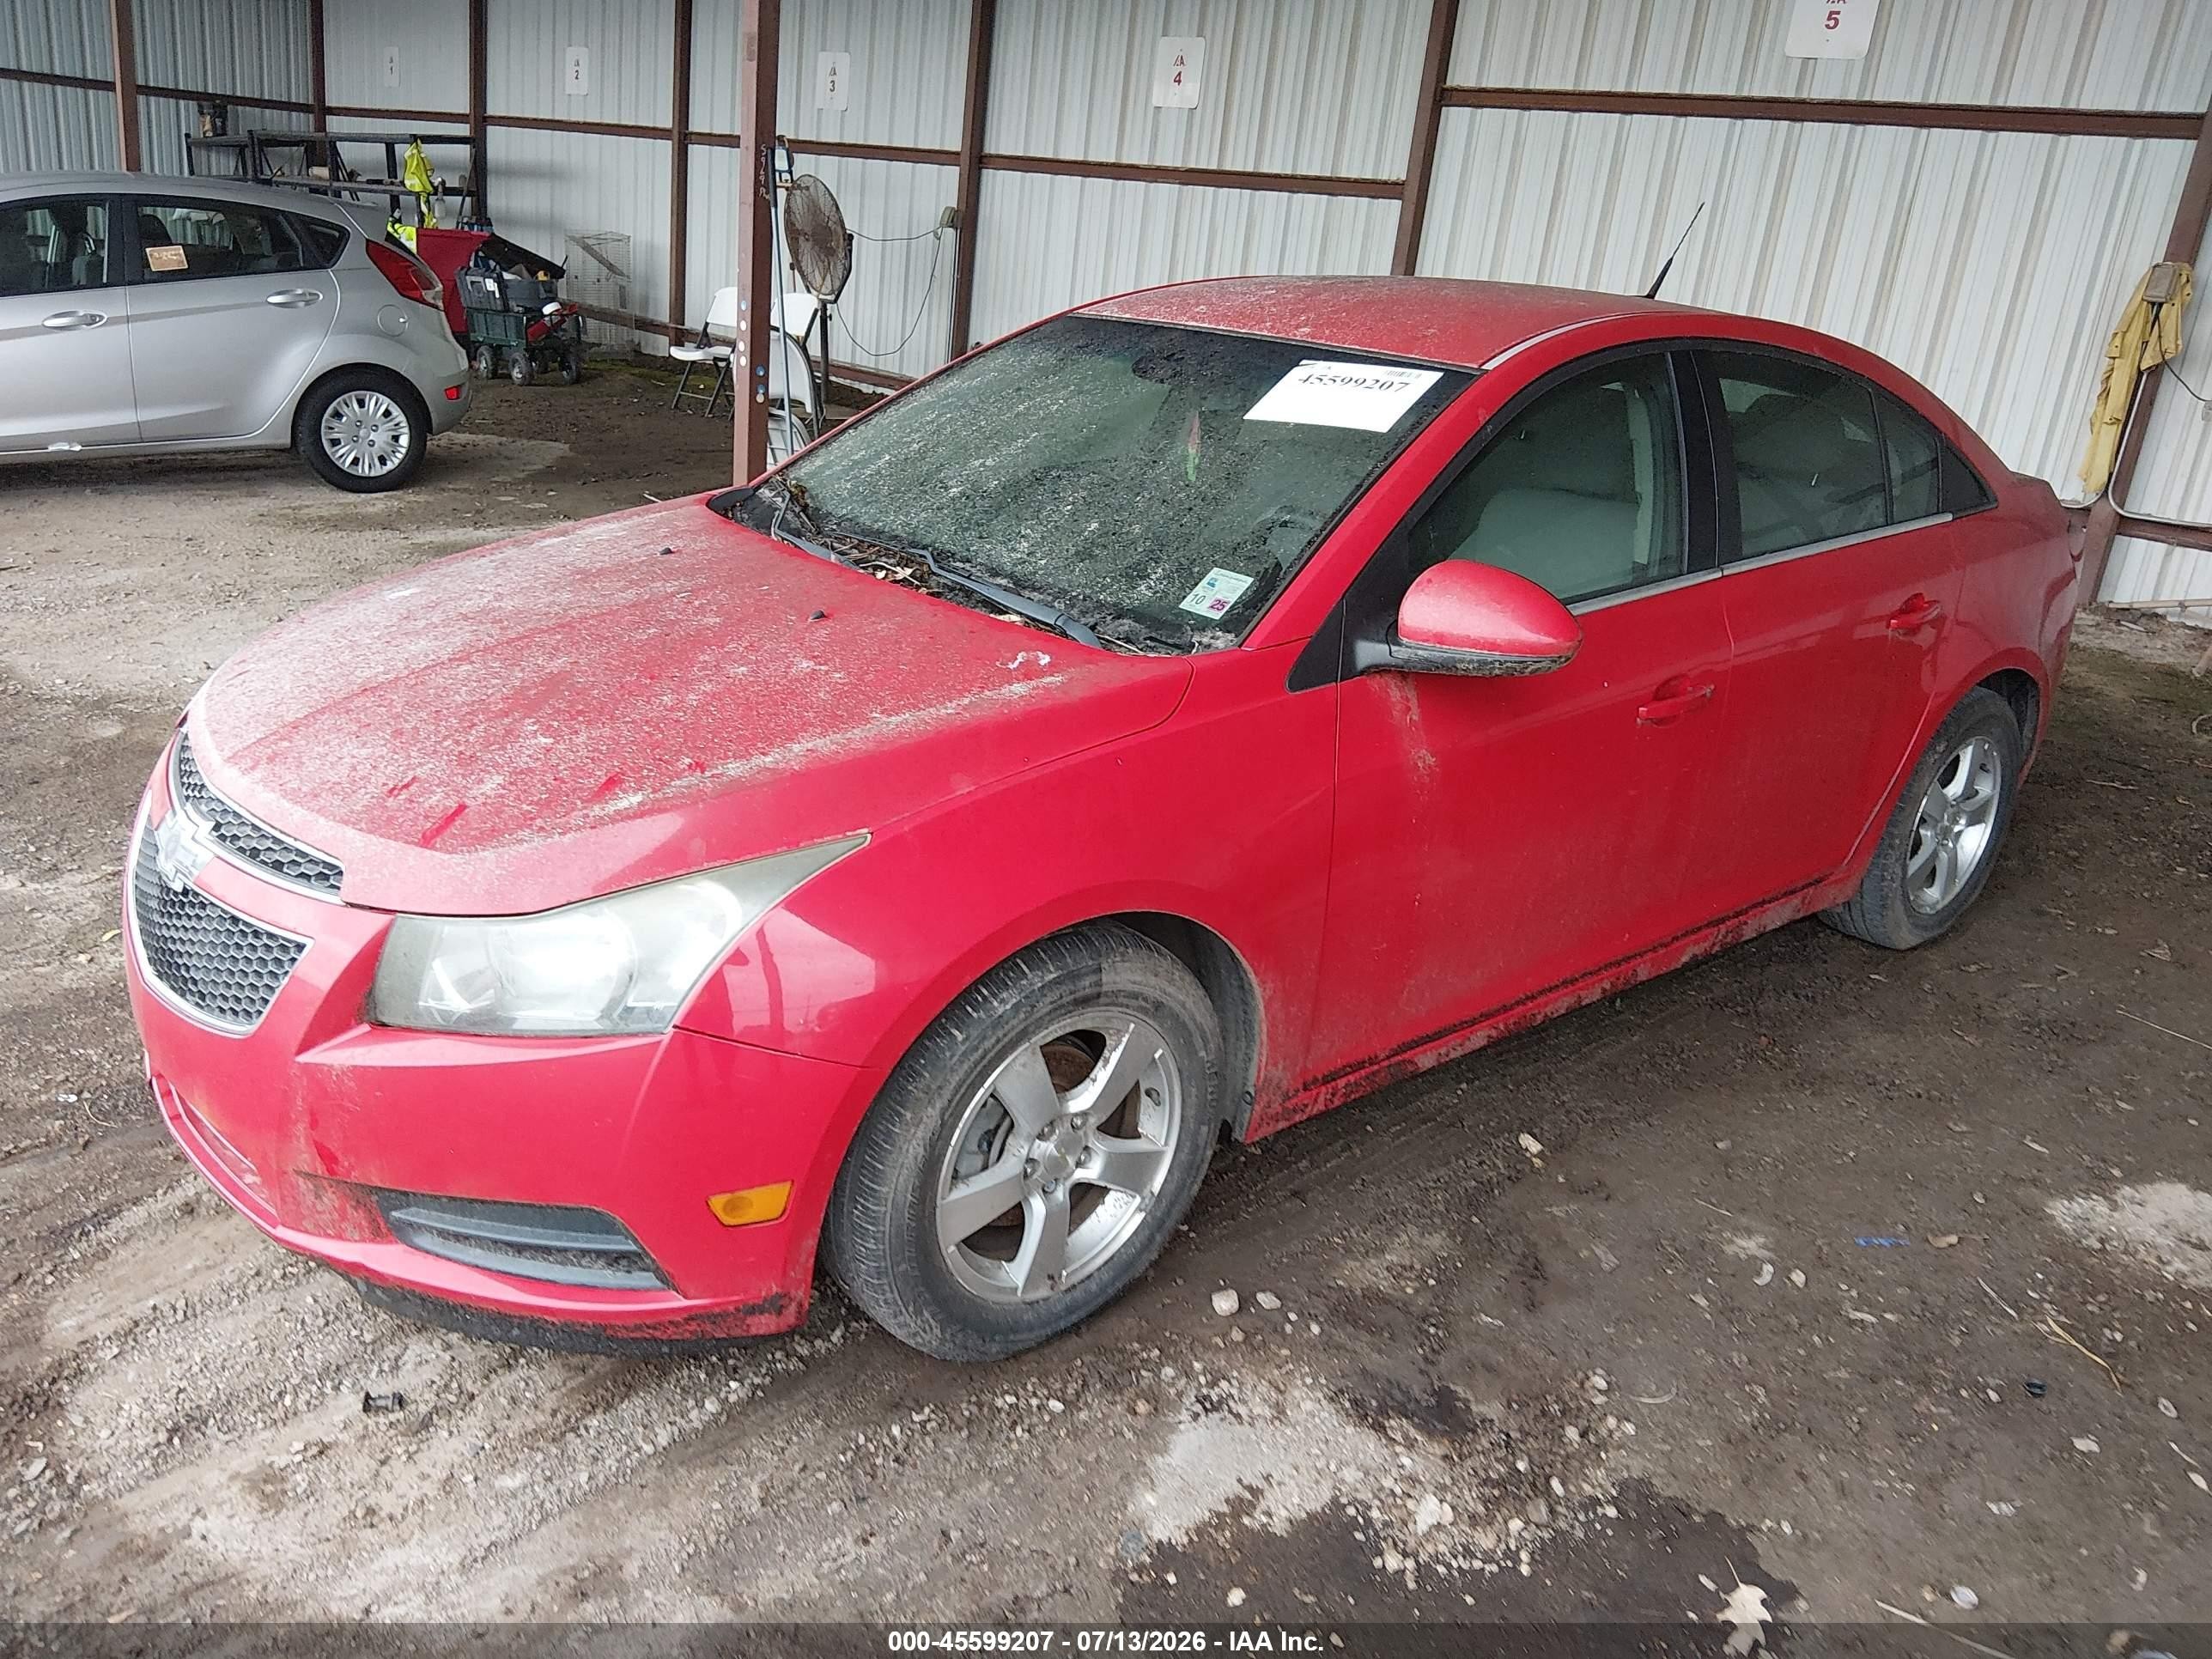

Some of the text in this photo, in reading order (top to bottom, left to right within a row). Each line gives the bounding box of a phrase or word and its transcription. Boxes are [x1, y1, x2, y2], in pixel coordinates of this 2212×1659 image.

[1825, 10, 1841, 30] 5
[574, 70, 580, 80] 2
[1173, 70, 1182, 86] 4
[830, 80, 836, 93] 3
[1297, 373, 1413, 393] 45599207
[1188, 592, 1230, 611] 10 25
